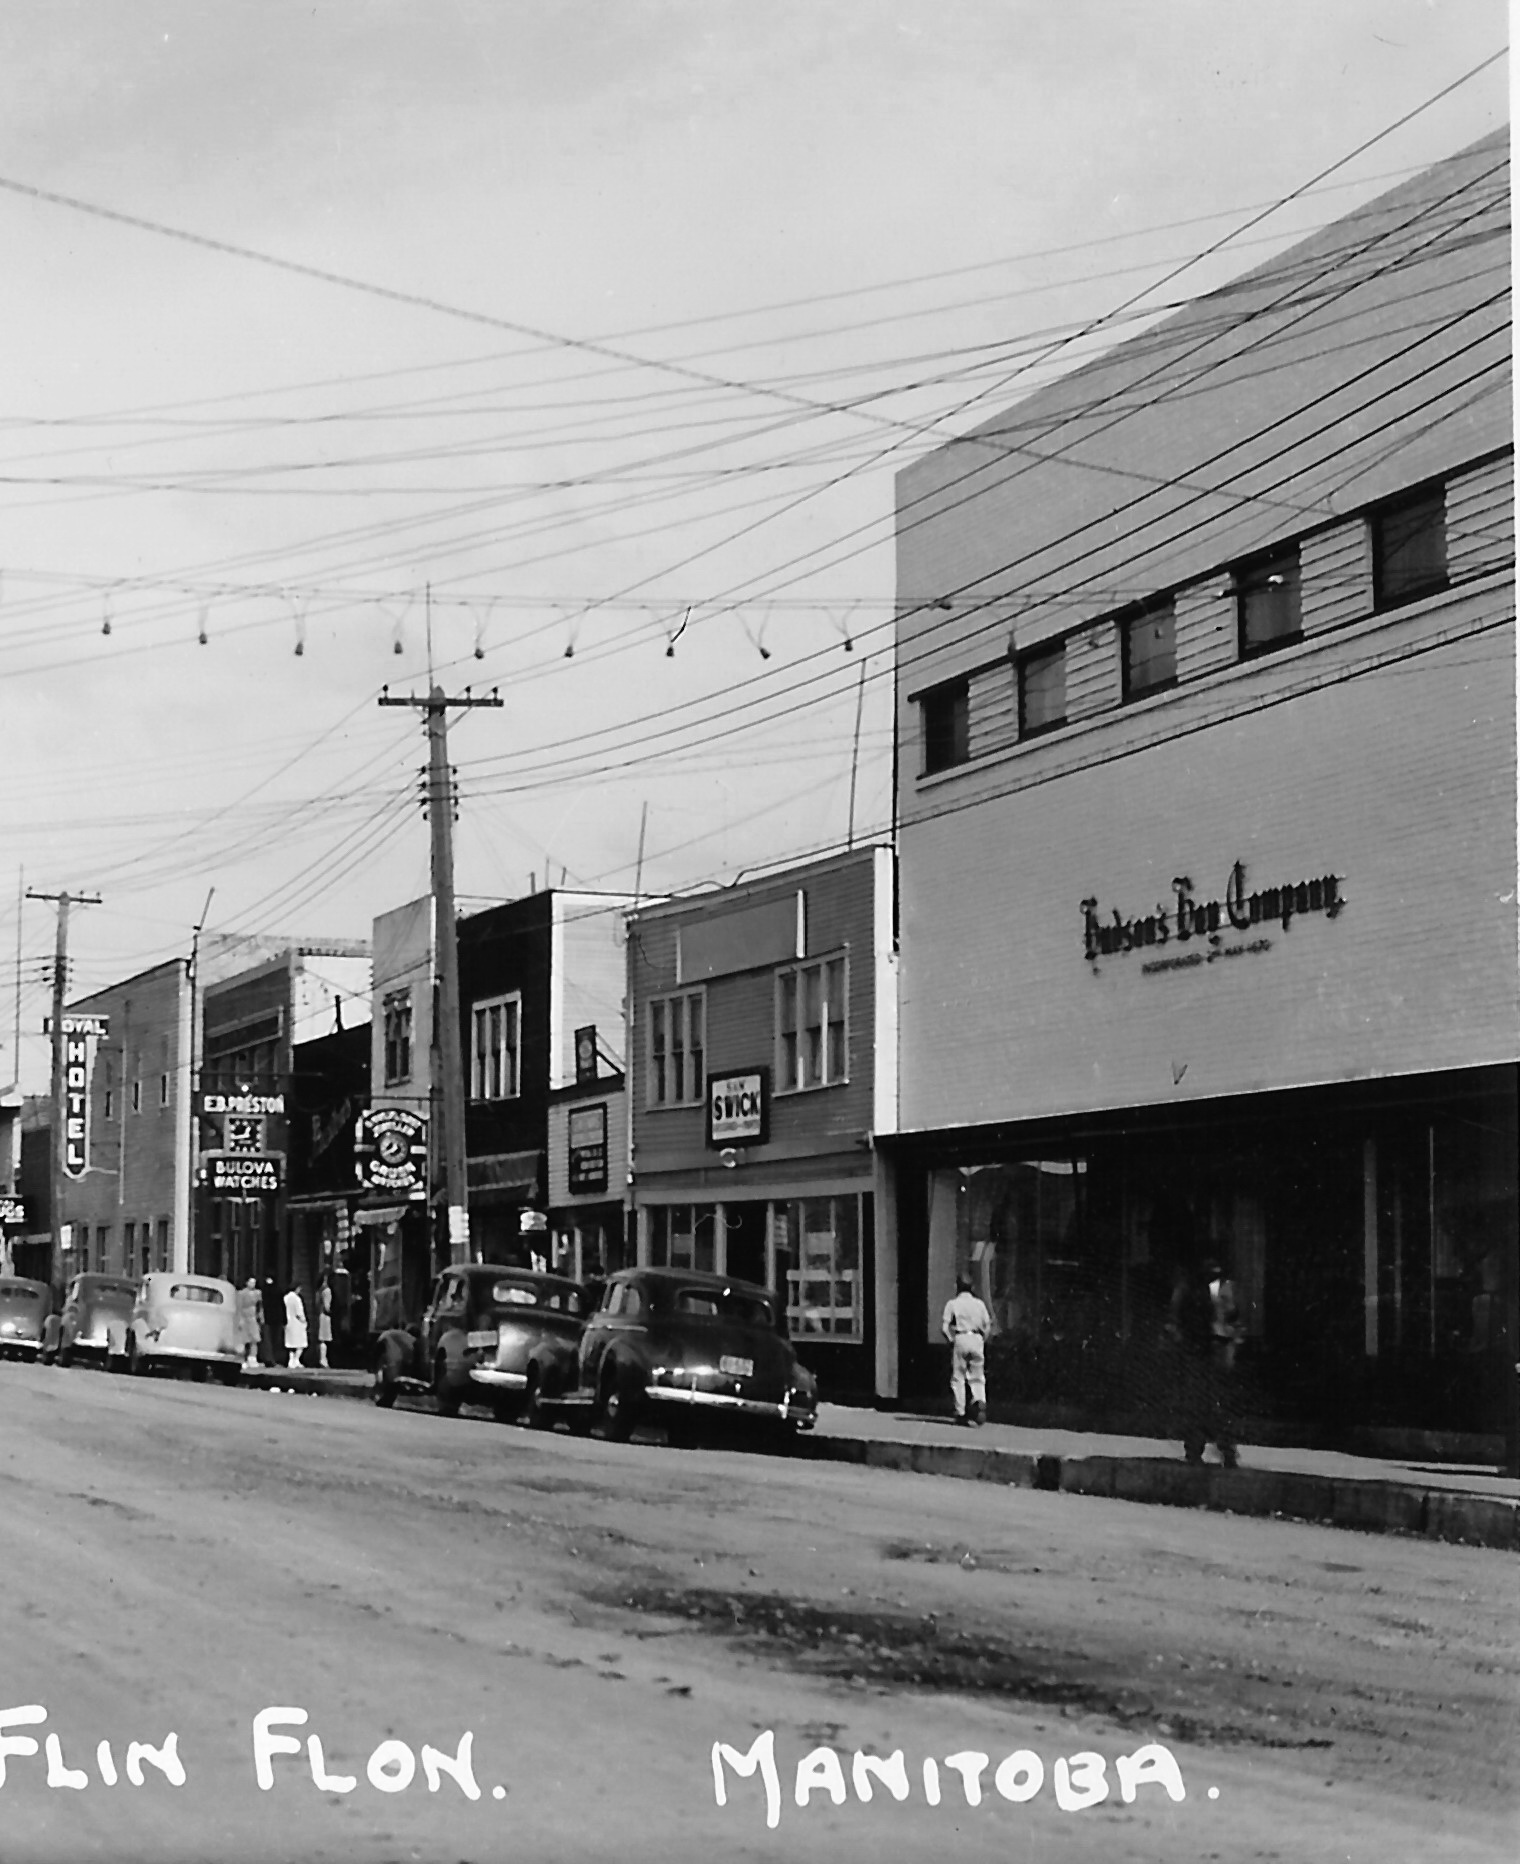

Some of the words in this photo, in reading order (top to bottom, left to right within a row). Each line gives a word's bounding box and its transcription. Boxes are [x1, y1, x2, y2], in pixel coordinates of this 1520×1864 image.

[1079, 895, 1170, 977] Hudson's
[1171, 875, 1221, 947] Bay
[1226, 860, 1348, 933] Company
[67, 1041, 85, 1165] HOTEL
[714, 1091, 760, 1121] SWICK
[215, 1160, 275, 1174] BULOVA
[213, 1175, 278, 1190] WATCHES
